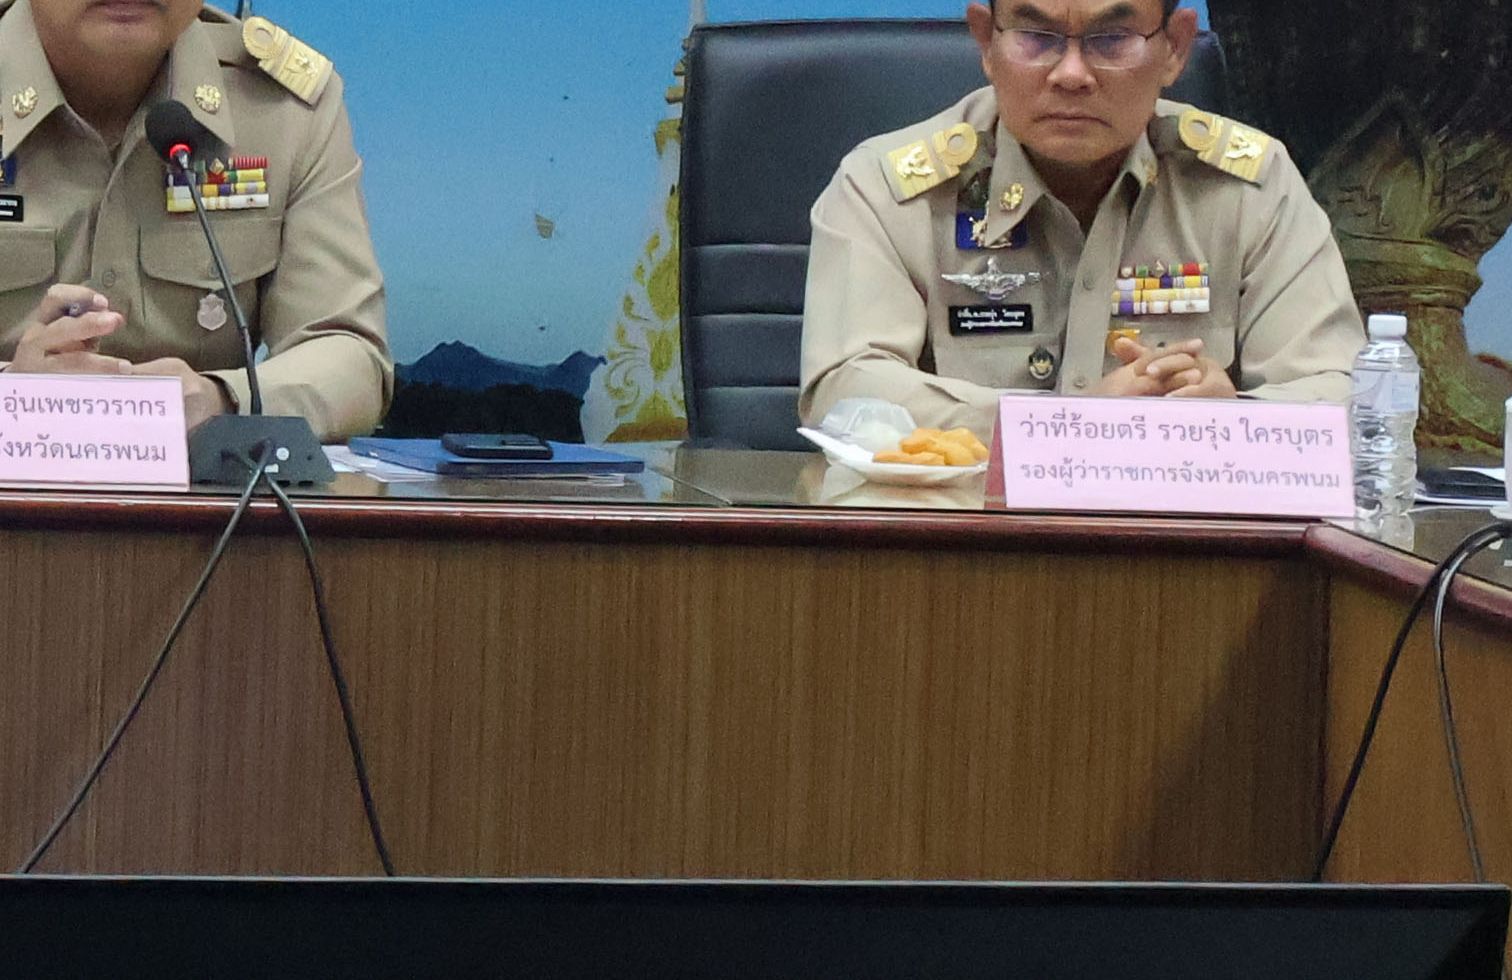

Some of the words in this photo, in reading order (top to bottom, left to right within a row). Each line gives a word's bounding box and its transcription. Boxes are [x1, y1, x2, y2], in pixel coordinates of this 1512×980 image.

[3, 389, 167, 421] อุ่นเพชรวรากร
[1020, 408, 1147, 441] ว่าที่ร้อยตรี
[1158, 418, 1231, 451] รวยรุ่ง
[1238, 416, 1334, 453] ใครบุตร
[1020, 456, 1340, 488] รองผู้ว่าราชการจังหวัดนครพนม
